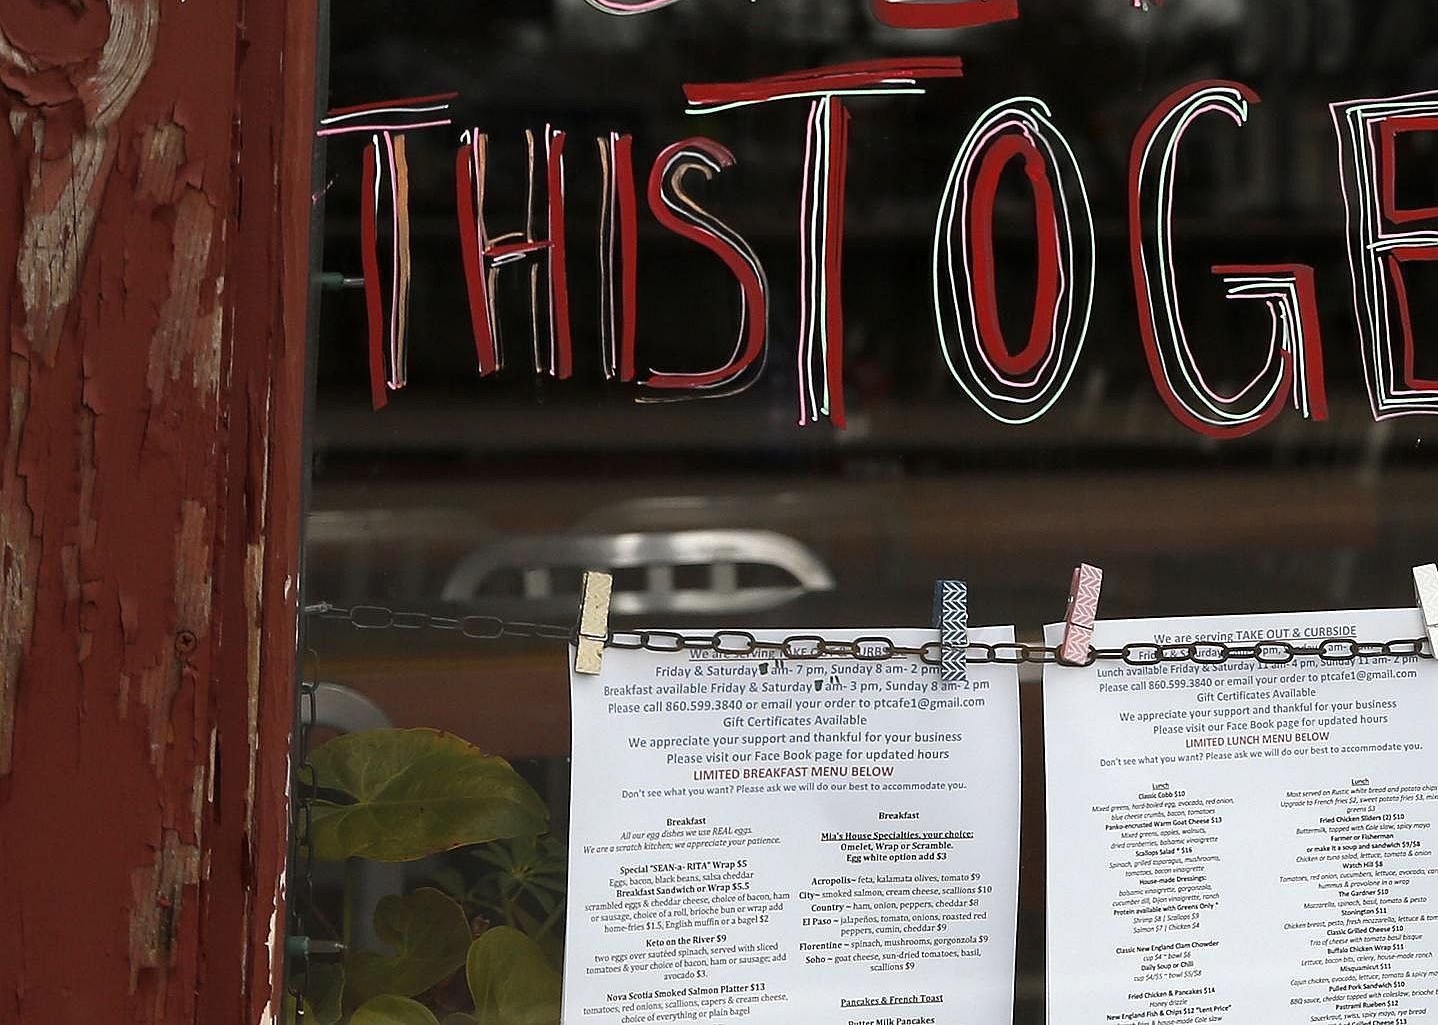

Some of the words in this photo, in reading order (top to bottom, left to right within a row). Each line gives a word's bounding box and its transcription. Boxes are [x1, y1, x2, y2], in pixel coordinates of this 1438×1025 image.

[316, 92, 769, 412] THIS
[1154, 634, 1171, 644] We
[1176, 635, 1192, 643] are
[1195, 632, 1233, 643] serving
[1236, 630, 1263, 641] TAKE
[1266, 628, 1289, 639] OUT
[1292, 628, 1300, 638] &
[1304, 626, 1356, 637] CURBSIDE
[655, 665, 691, 678] Friday
[694, 666, 704, 676] &
[707, 665, 758, 678] Saturday
[797, 664, 803, 674] 7
[806, 666, 827, 676] pm,
[831, 664, 871, 676] Sunday
[875, 664, 882, 674] 8
[885, 665, 908, 674] am-
[911, 664, 918, 674] 2
[604, 684, 653, 696] Breakfast
[656, 683, 707, 695] available
[711, 682, 746, 695] Friday
[750, 683, 759, 693] &
[762, 681, 812, 693] Saturday
[851, 681, 857, 691] 3
[861, 682, 882, 693] pm,
[885, 681, 928, 693] Sunday
[931, 681, 937, 690] 8
[942, 682, 961, 691] am-
[964, 680, 970, 689] 2
[973, 680, 990, 691] pm
[1197, 692, 1214, 702] Gift
[1216, 689, 1270, 701] Certificates
[1272, 687, 1316, 700] Available
[608, 702, 640, 713] Please
[643, 701, 662, 712] call
[665, 699, 744, 711] 860.599.3840
[745, 701, 759, 711] or
[760, 698, 792, 712] email
[795, 698, 822, 713] your
[824, 697, 856, 713] order
[858, 698, 872, 711] to
[874, 696, 984, 711] ptcafe1@gmail.com
[723, 716, 744, 727] Gift
[747, 715, 813, 727] Certificates
[814, 714, 867, 725] Available
[628, 737, 646, 747] We
[650, 735, 709, 749] appreciate
[712, 736, 739, 748] your
[741, 733, 786, 746] support
[789, 732, 810, 743] and
[813, 731, 861, 742] thankful
[865, 731, 882, 742] for
[884, 734, 911, 744] your
[914, 731, 962, 742] business
[1185, 737, 1226, 748] LIMITED
[1227, 735, 1259, 745] LUNCH
[1262, 733, 1292, 743] MENU
[1295, 731, 1329, 742] BELOW
[667, 753, 702, 766] Please
[705, 751, 728, 762] visit
[732, 752, 752, 762] our
[754, 751, 781, 761] Face
[783, 750, 813, 761] Book
[815, 752, 842, 763] page
[846, 749, 864, 760] for
[866, 749, 916, 761] updated
[917, 749, 950, 759] hours
[694, 769, 740, 780] LIMITED
[743, 766, 808, 778] BREAKFAST
[811, 766, 847, 776] MENU
[849, 766, 894, 776] BELOW
[879, 811, 919, 822] Breakfast
